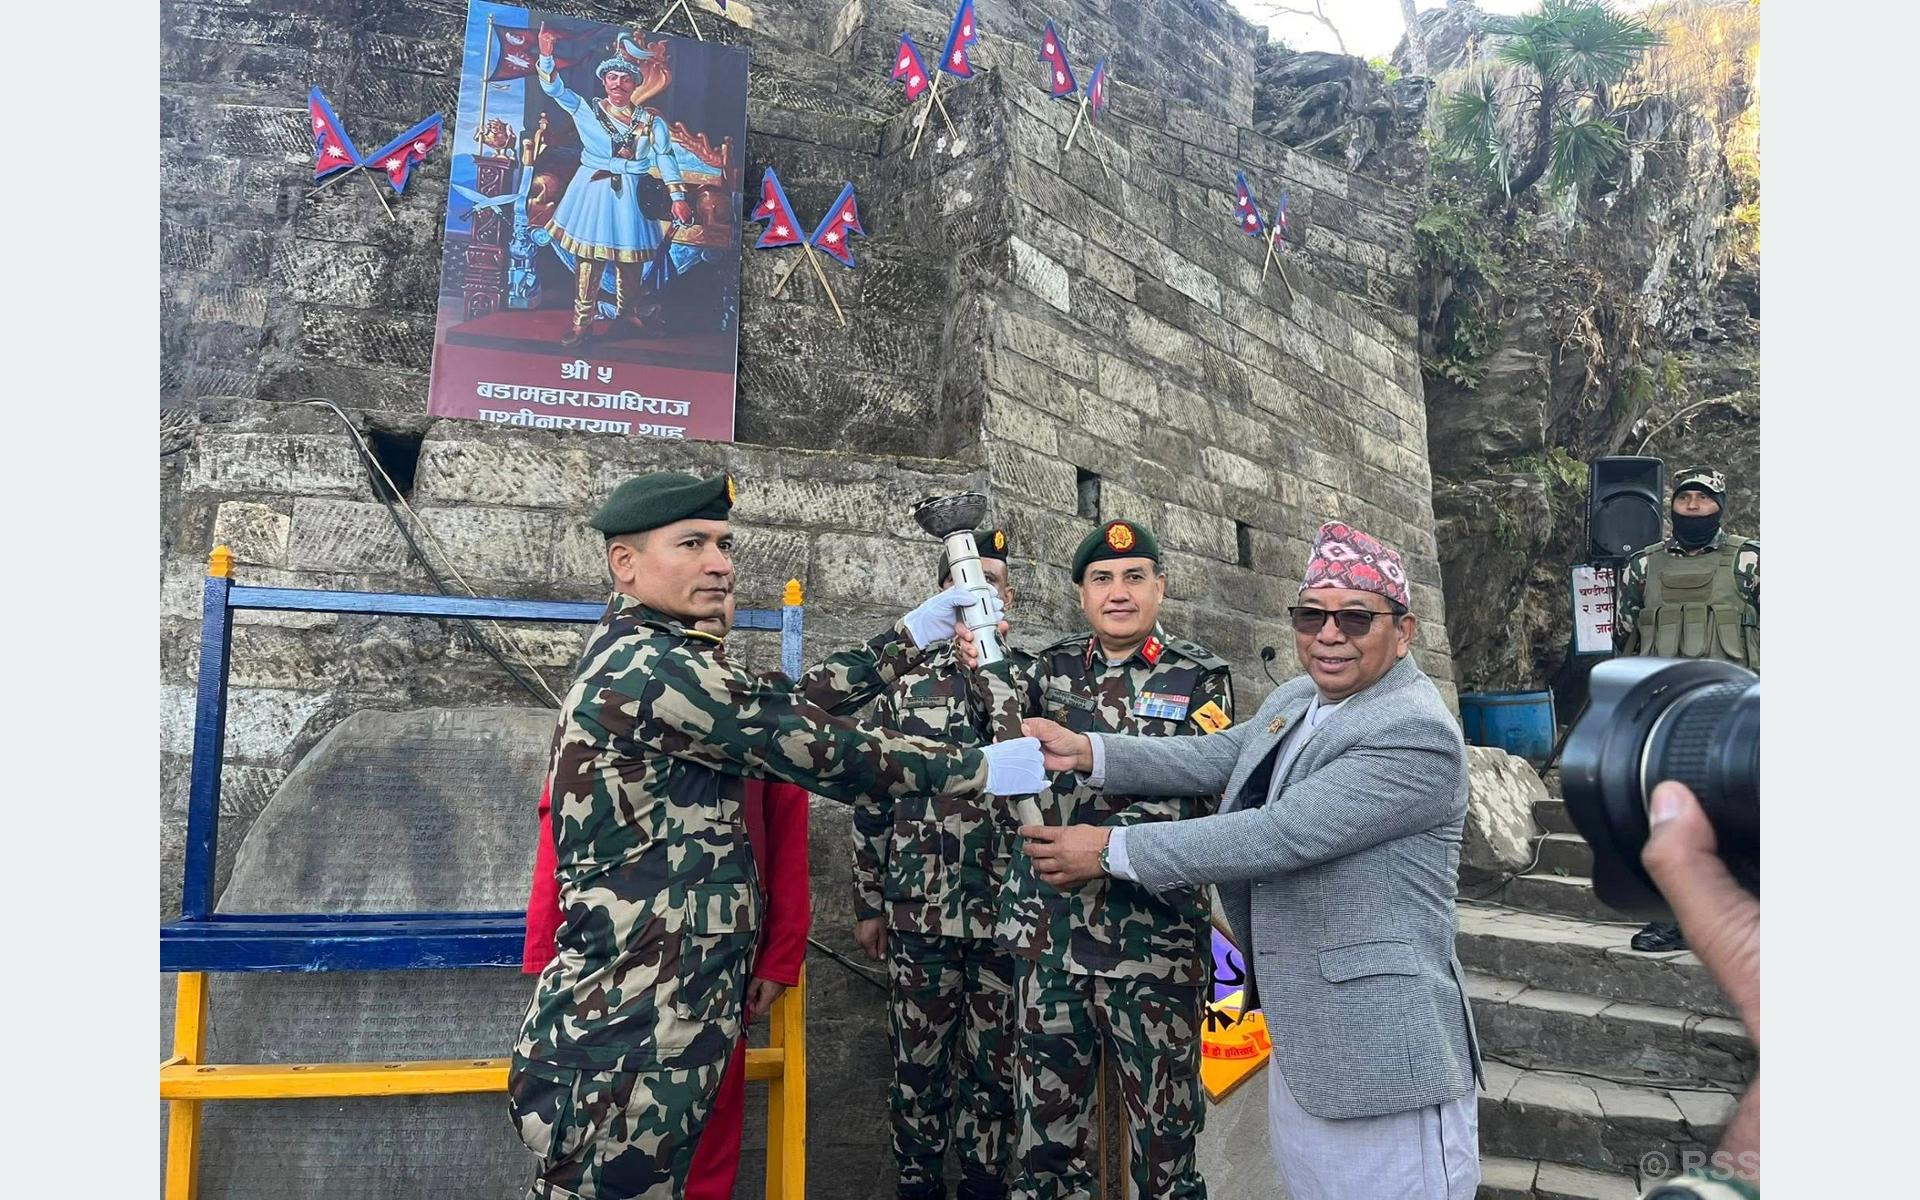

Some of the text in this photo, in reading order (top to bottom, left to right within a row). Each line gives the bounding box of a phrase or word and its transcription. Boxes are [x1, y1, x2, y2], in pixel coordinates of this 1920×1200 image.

[560, 359, 613, 384] श्री ५
[476, 380, 691, 417] बडामहाराजाधिराज
